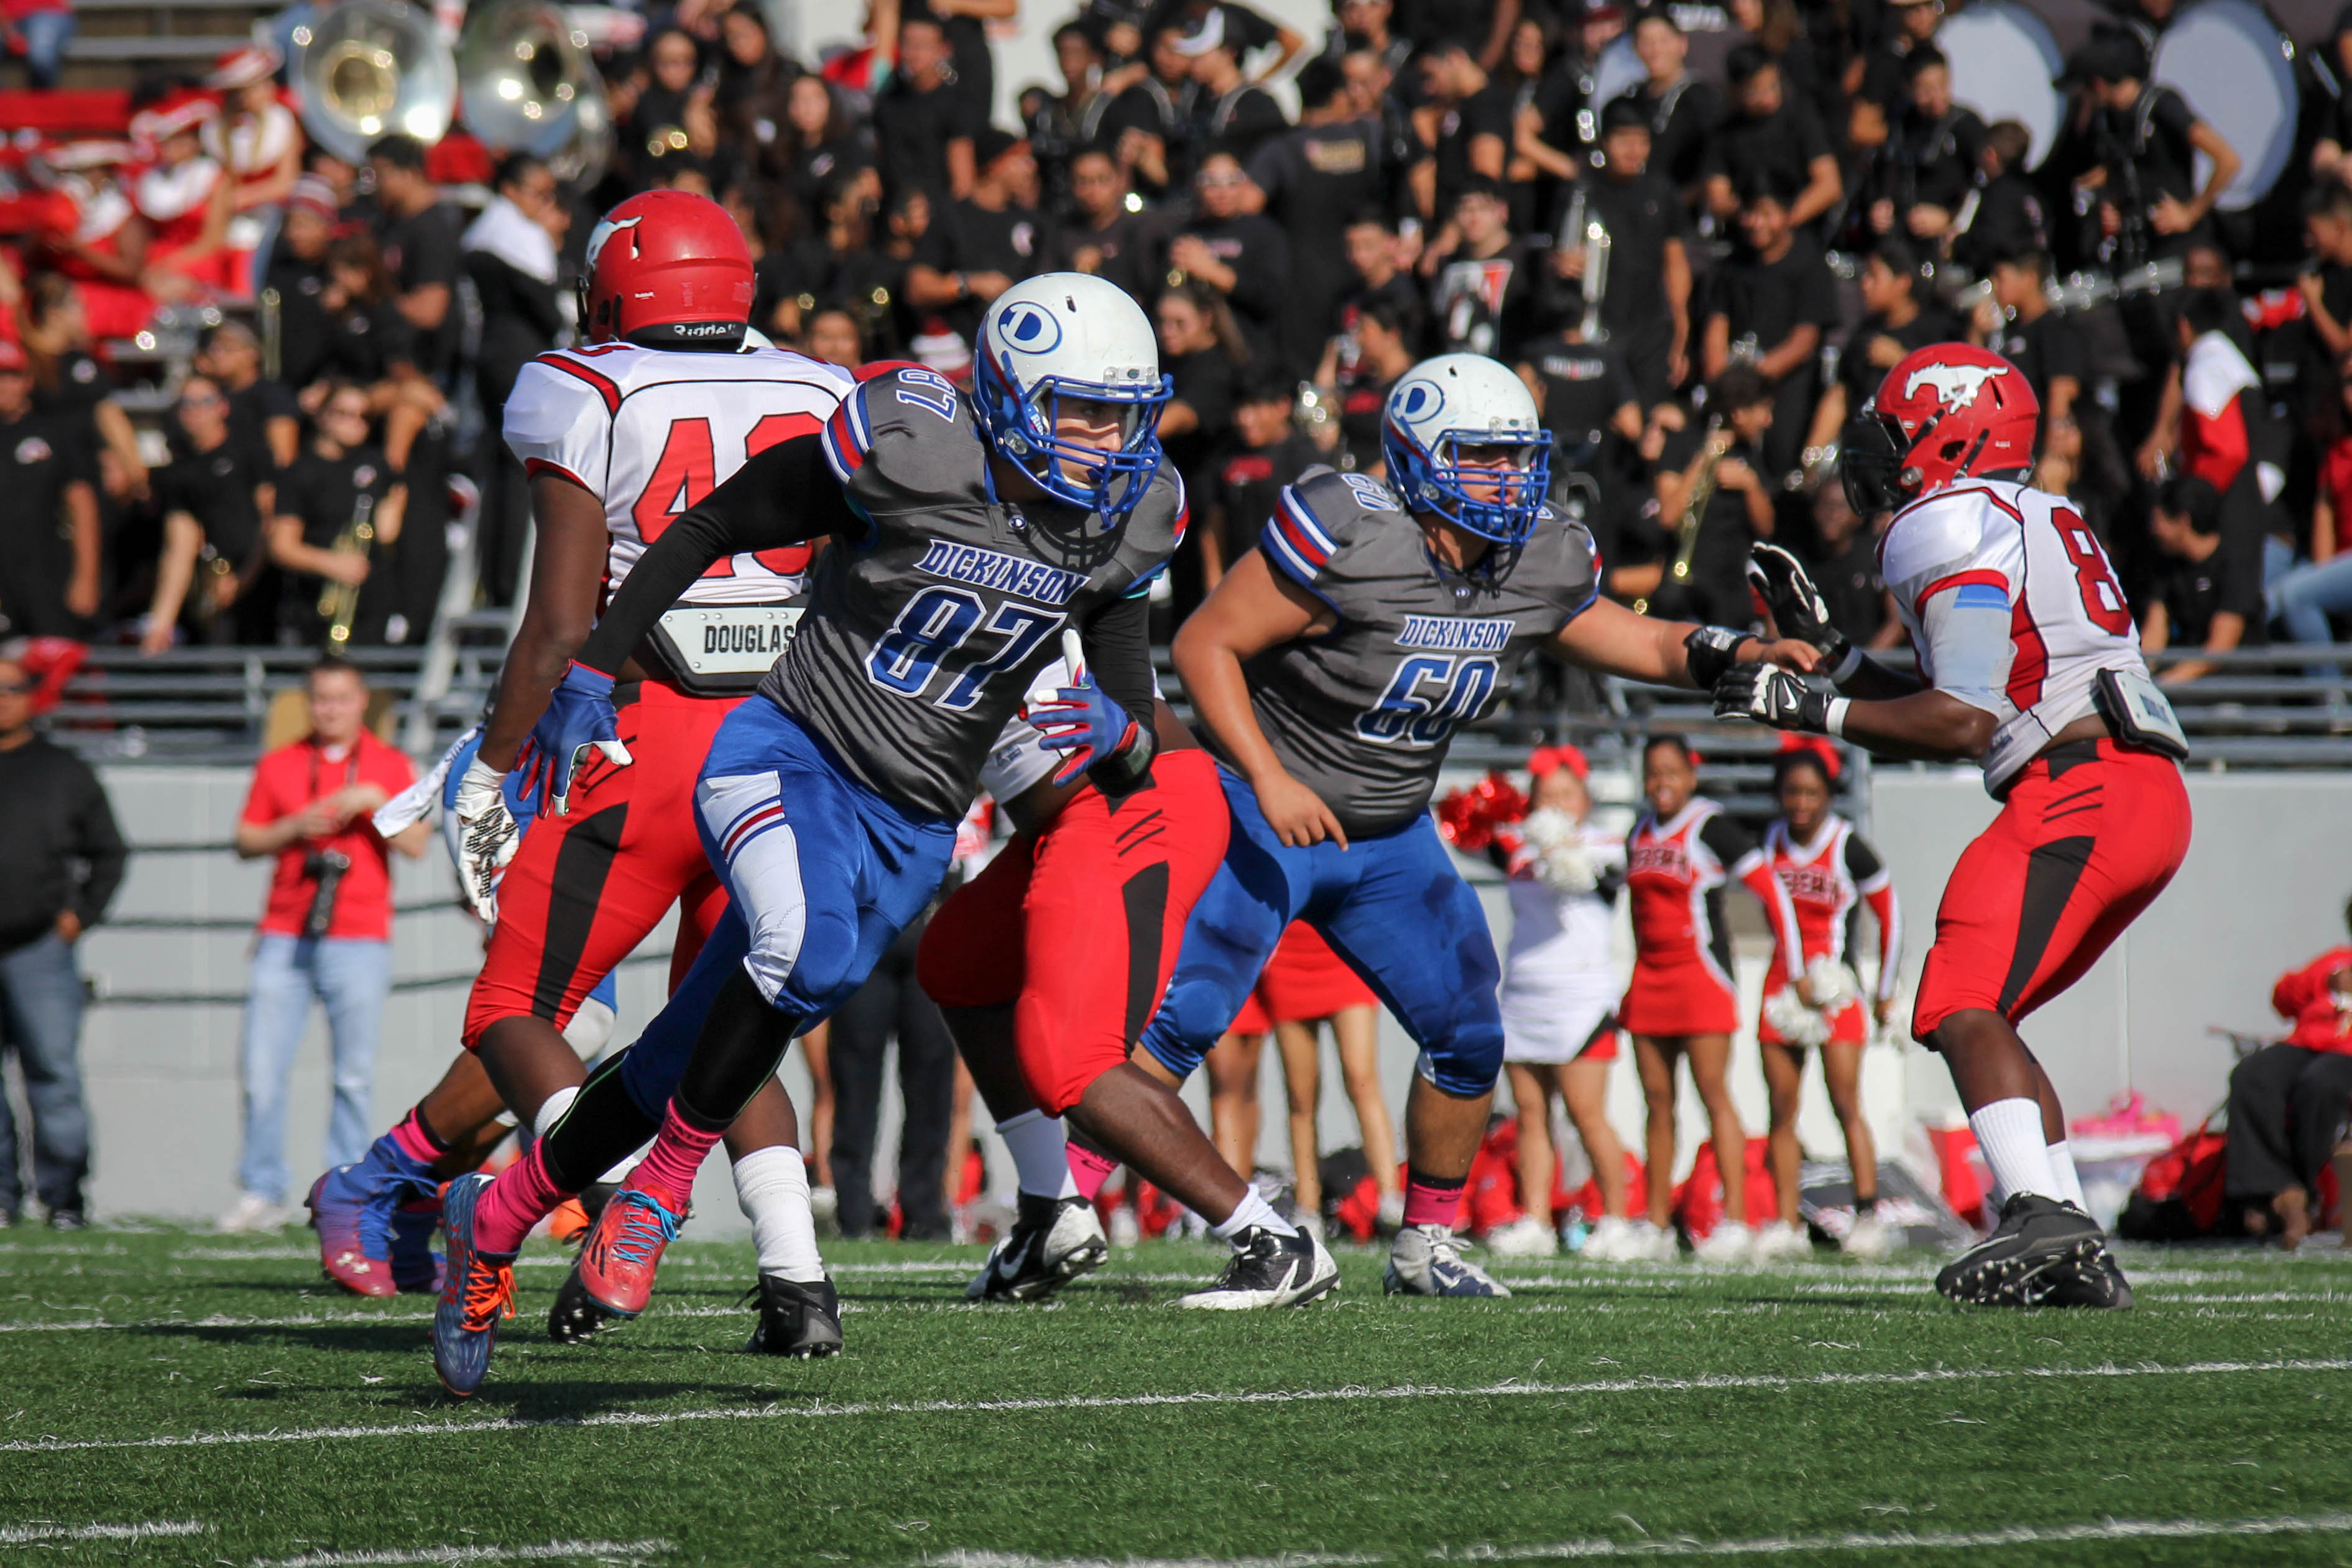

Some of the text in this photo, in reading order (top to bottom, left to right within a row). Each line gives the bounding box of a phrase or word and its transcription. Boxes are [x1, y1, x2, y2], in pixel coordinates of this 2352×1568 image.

[674, 323, 736, 336] Riddel
[896, 369, 957, 423] 87
[913, 538, 1092, 606] DICKINSON
[864, 584, 1069, 711] 87
[1393, 614, 1516, 652] DICKINSON
[1353, 652, 1500, 747] 60
